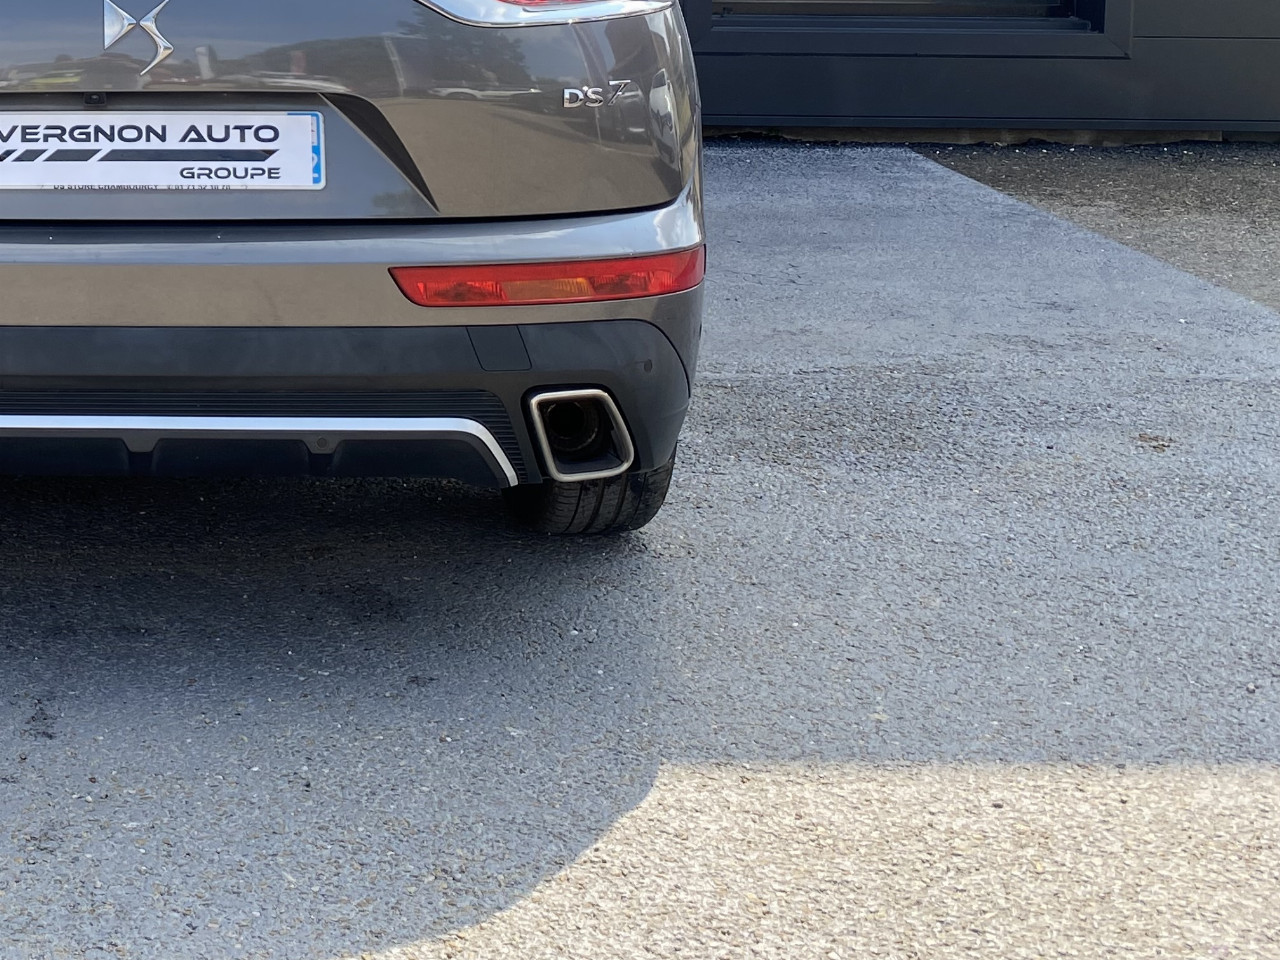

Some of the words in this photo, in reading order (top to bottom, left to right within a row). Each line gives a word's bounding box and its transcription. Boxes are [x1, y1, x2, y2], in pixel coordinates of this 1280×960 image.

[563, 86, 603, 108] DS
[608, 80, 631, 106] 7
[178, 124, 280, 143] AUTO
[179, 166, 281, 180] GROUPE
